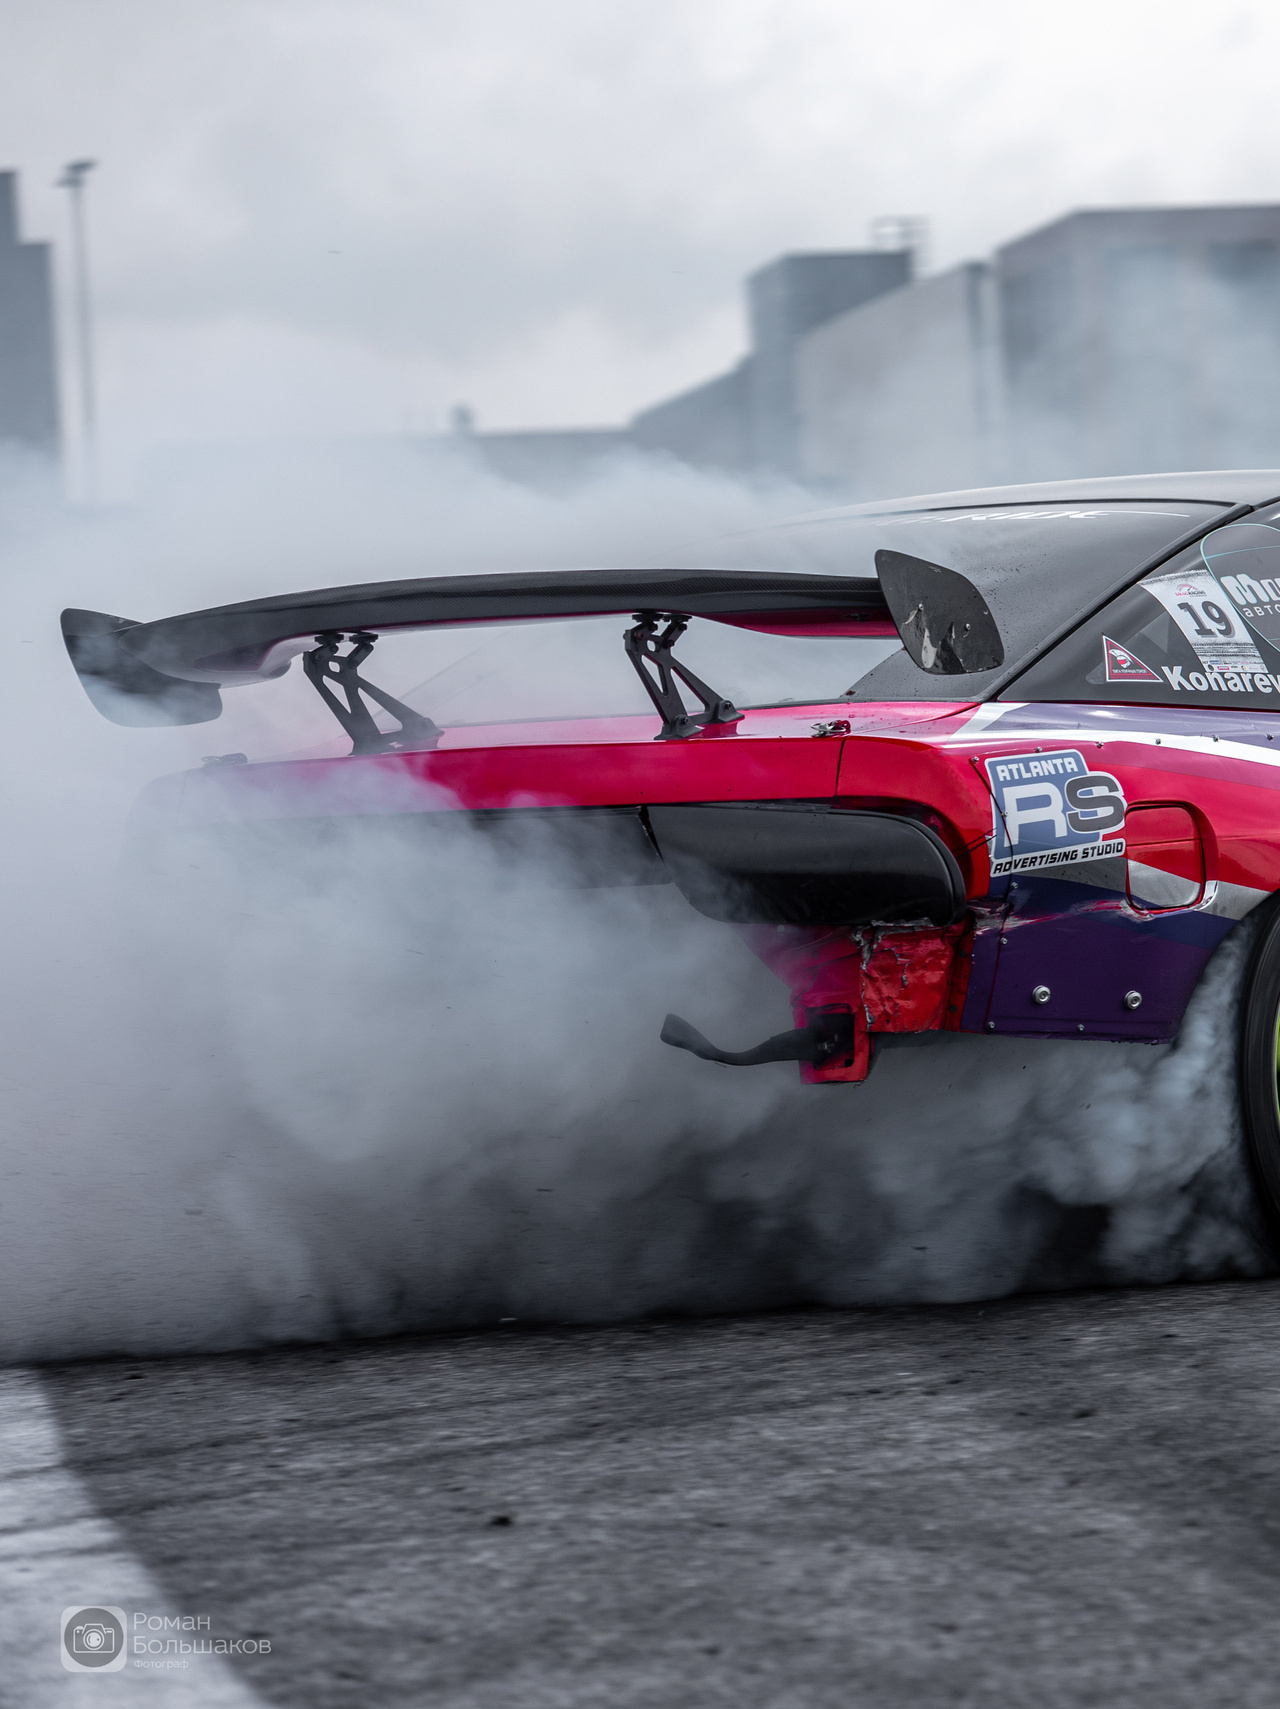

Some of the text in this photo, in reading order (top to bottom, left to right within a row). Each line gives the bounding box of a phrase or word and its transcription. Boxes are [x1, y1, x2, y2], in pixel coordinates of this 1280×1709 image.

[1177, 600, 1236, 639] 19
[996, 757, 1079, 782] ATLANTA
[1002, 775, 1127, 848] RS
[993, 841, 1124, 875] ADVERTISING STUDIO
